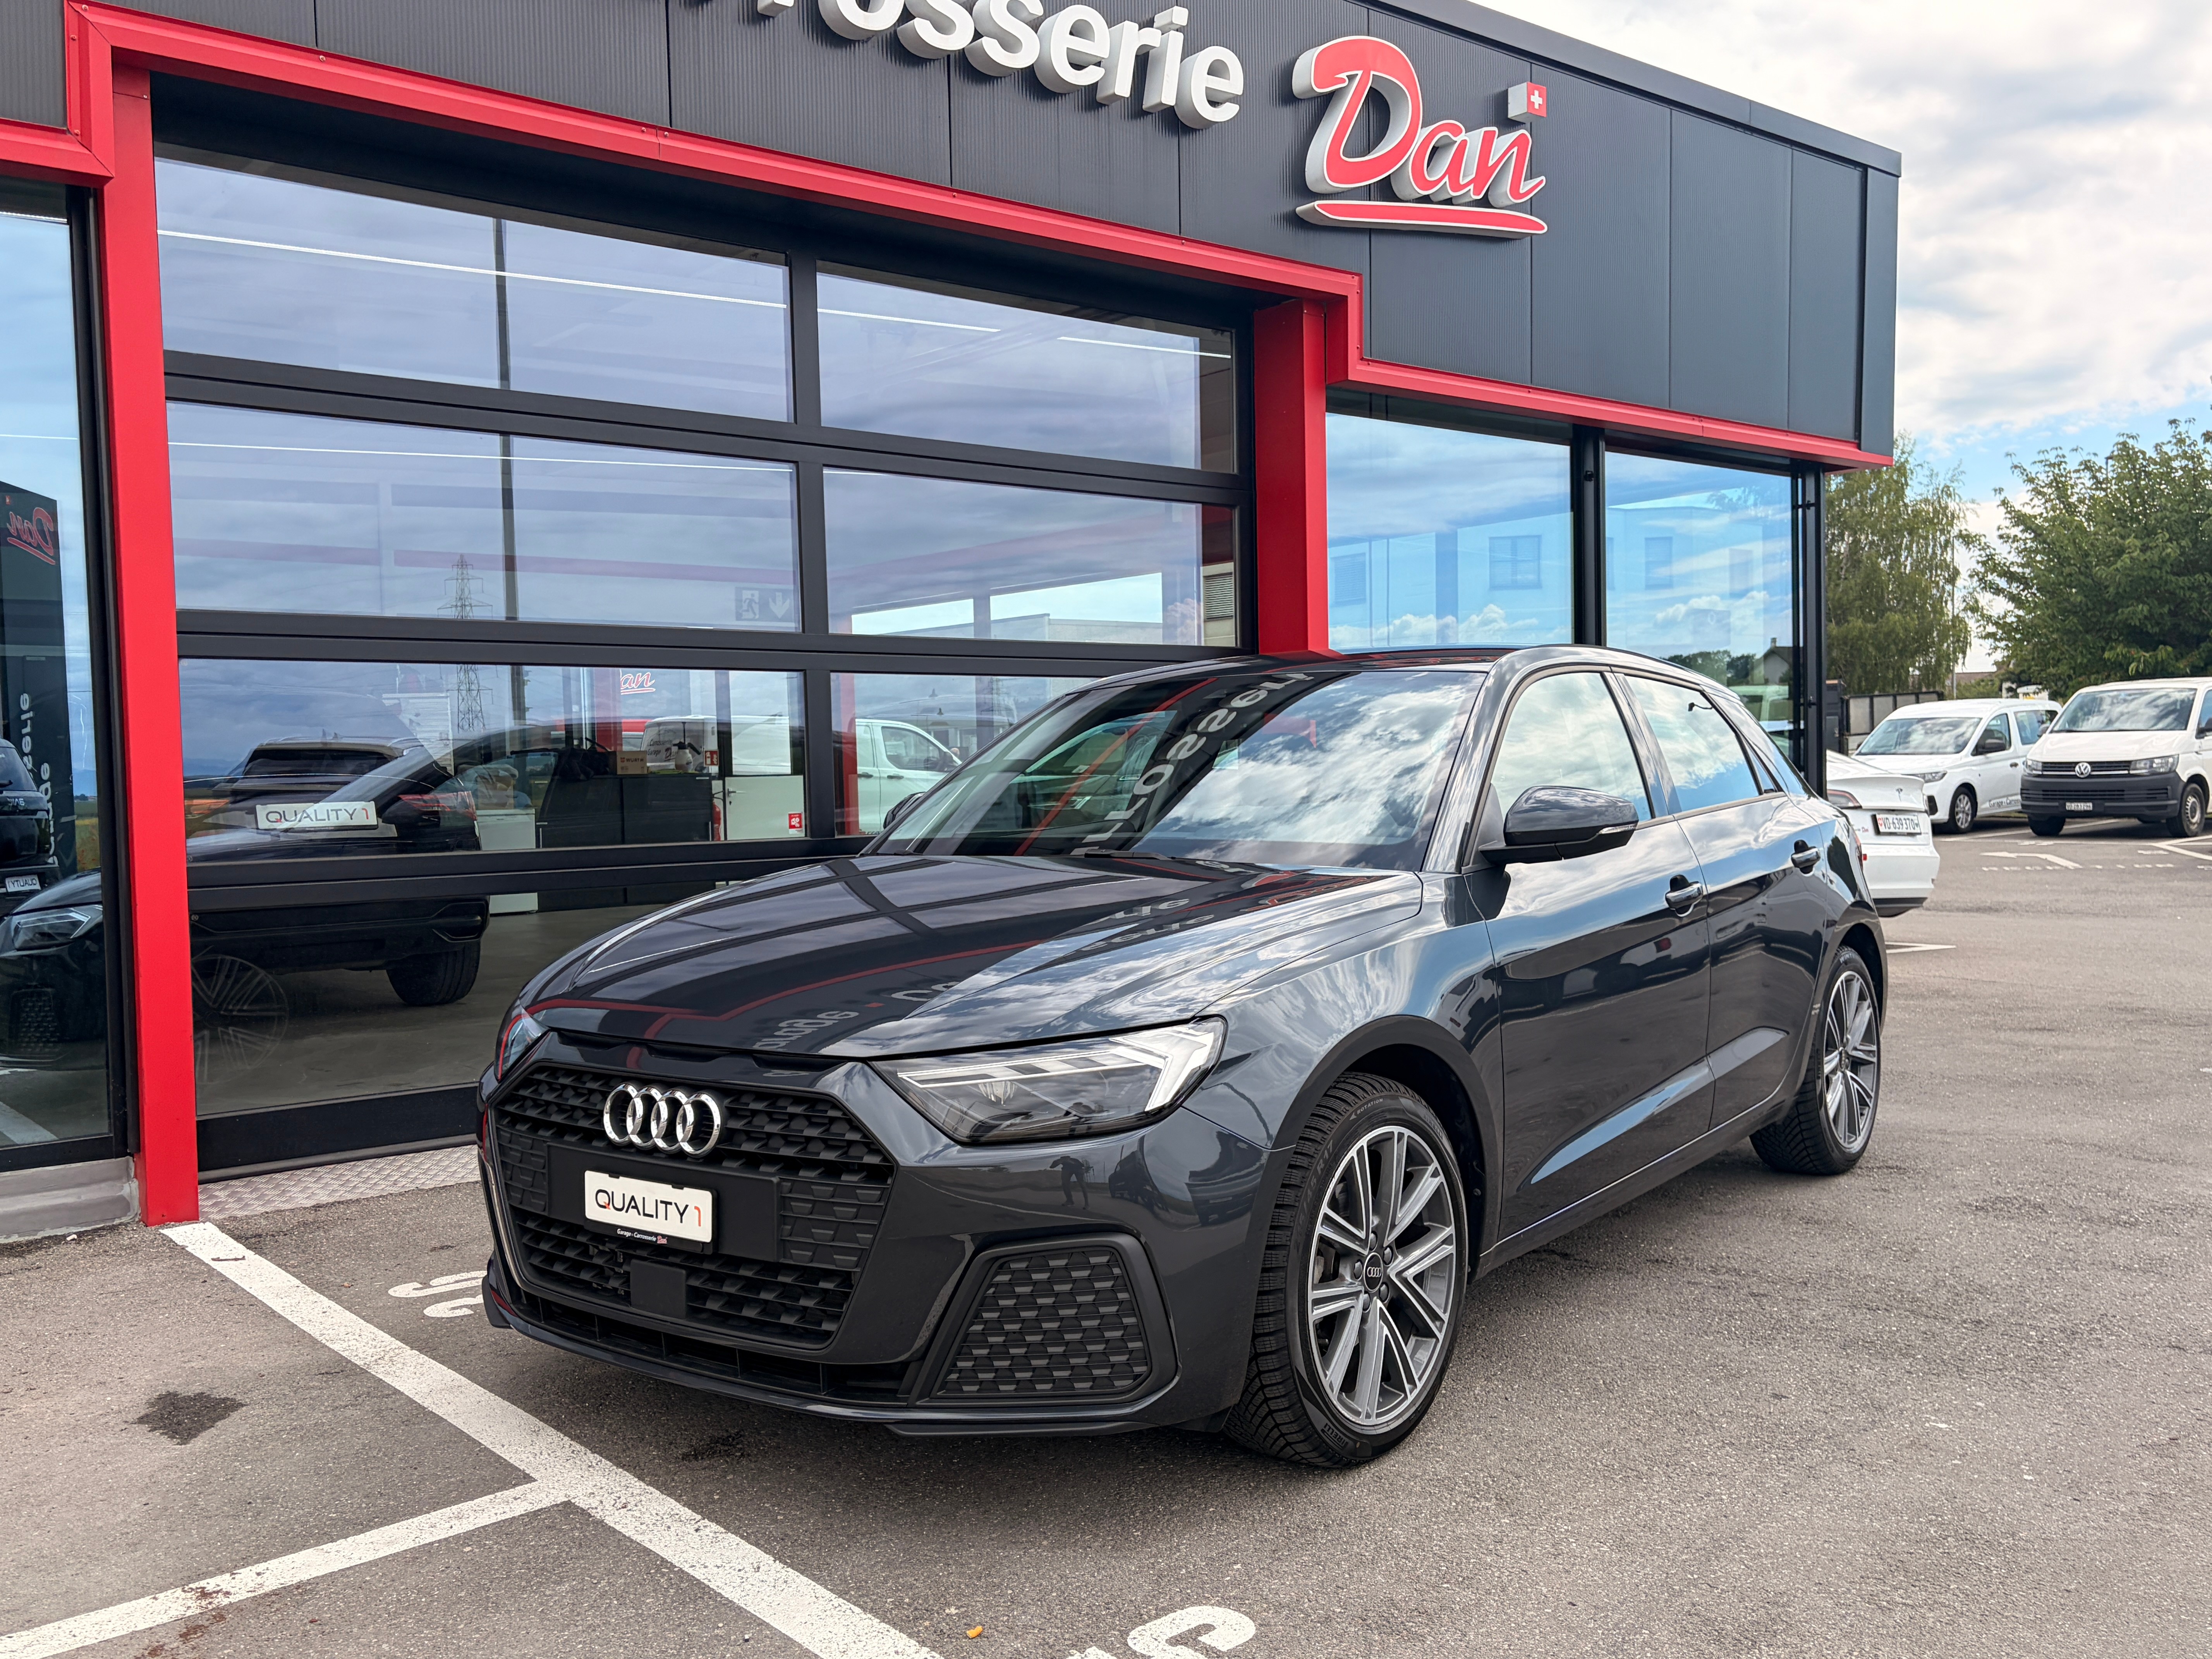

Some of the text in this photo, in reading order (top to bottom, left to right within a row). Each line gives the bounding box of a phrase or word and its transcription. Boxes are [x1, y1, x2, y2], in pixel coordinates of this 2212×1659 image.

[1292, 35, 1546, 208] Dan
[620, 669, 655, 689] an
[266, 808, 357, 823] QUALITY
[1357, 1098, 1383, 1114] ROTATION
[595, 1189, 689, 1223] QUALITY
[617, 1229, 631, 1237] Garage
